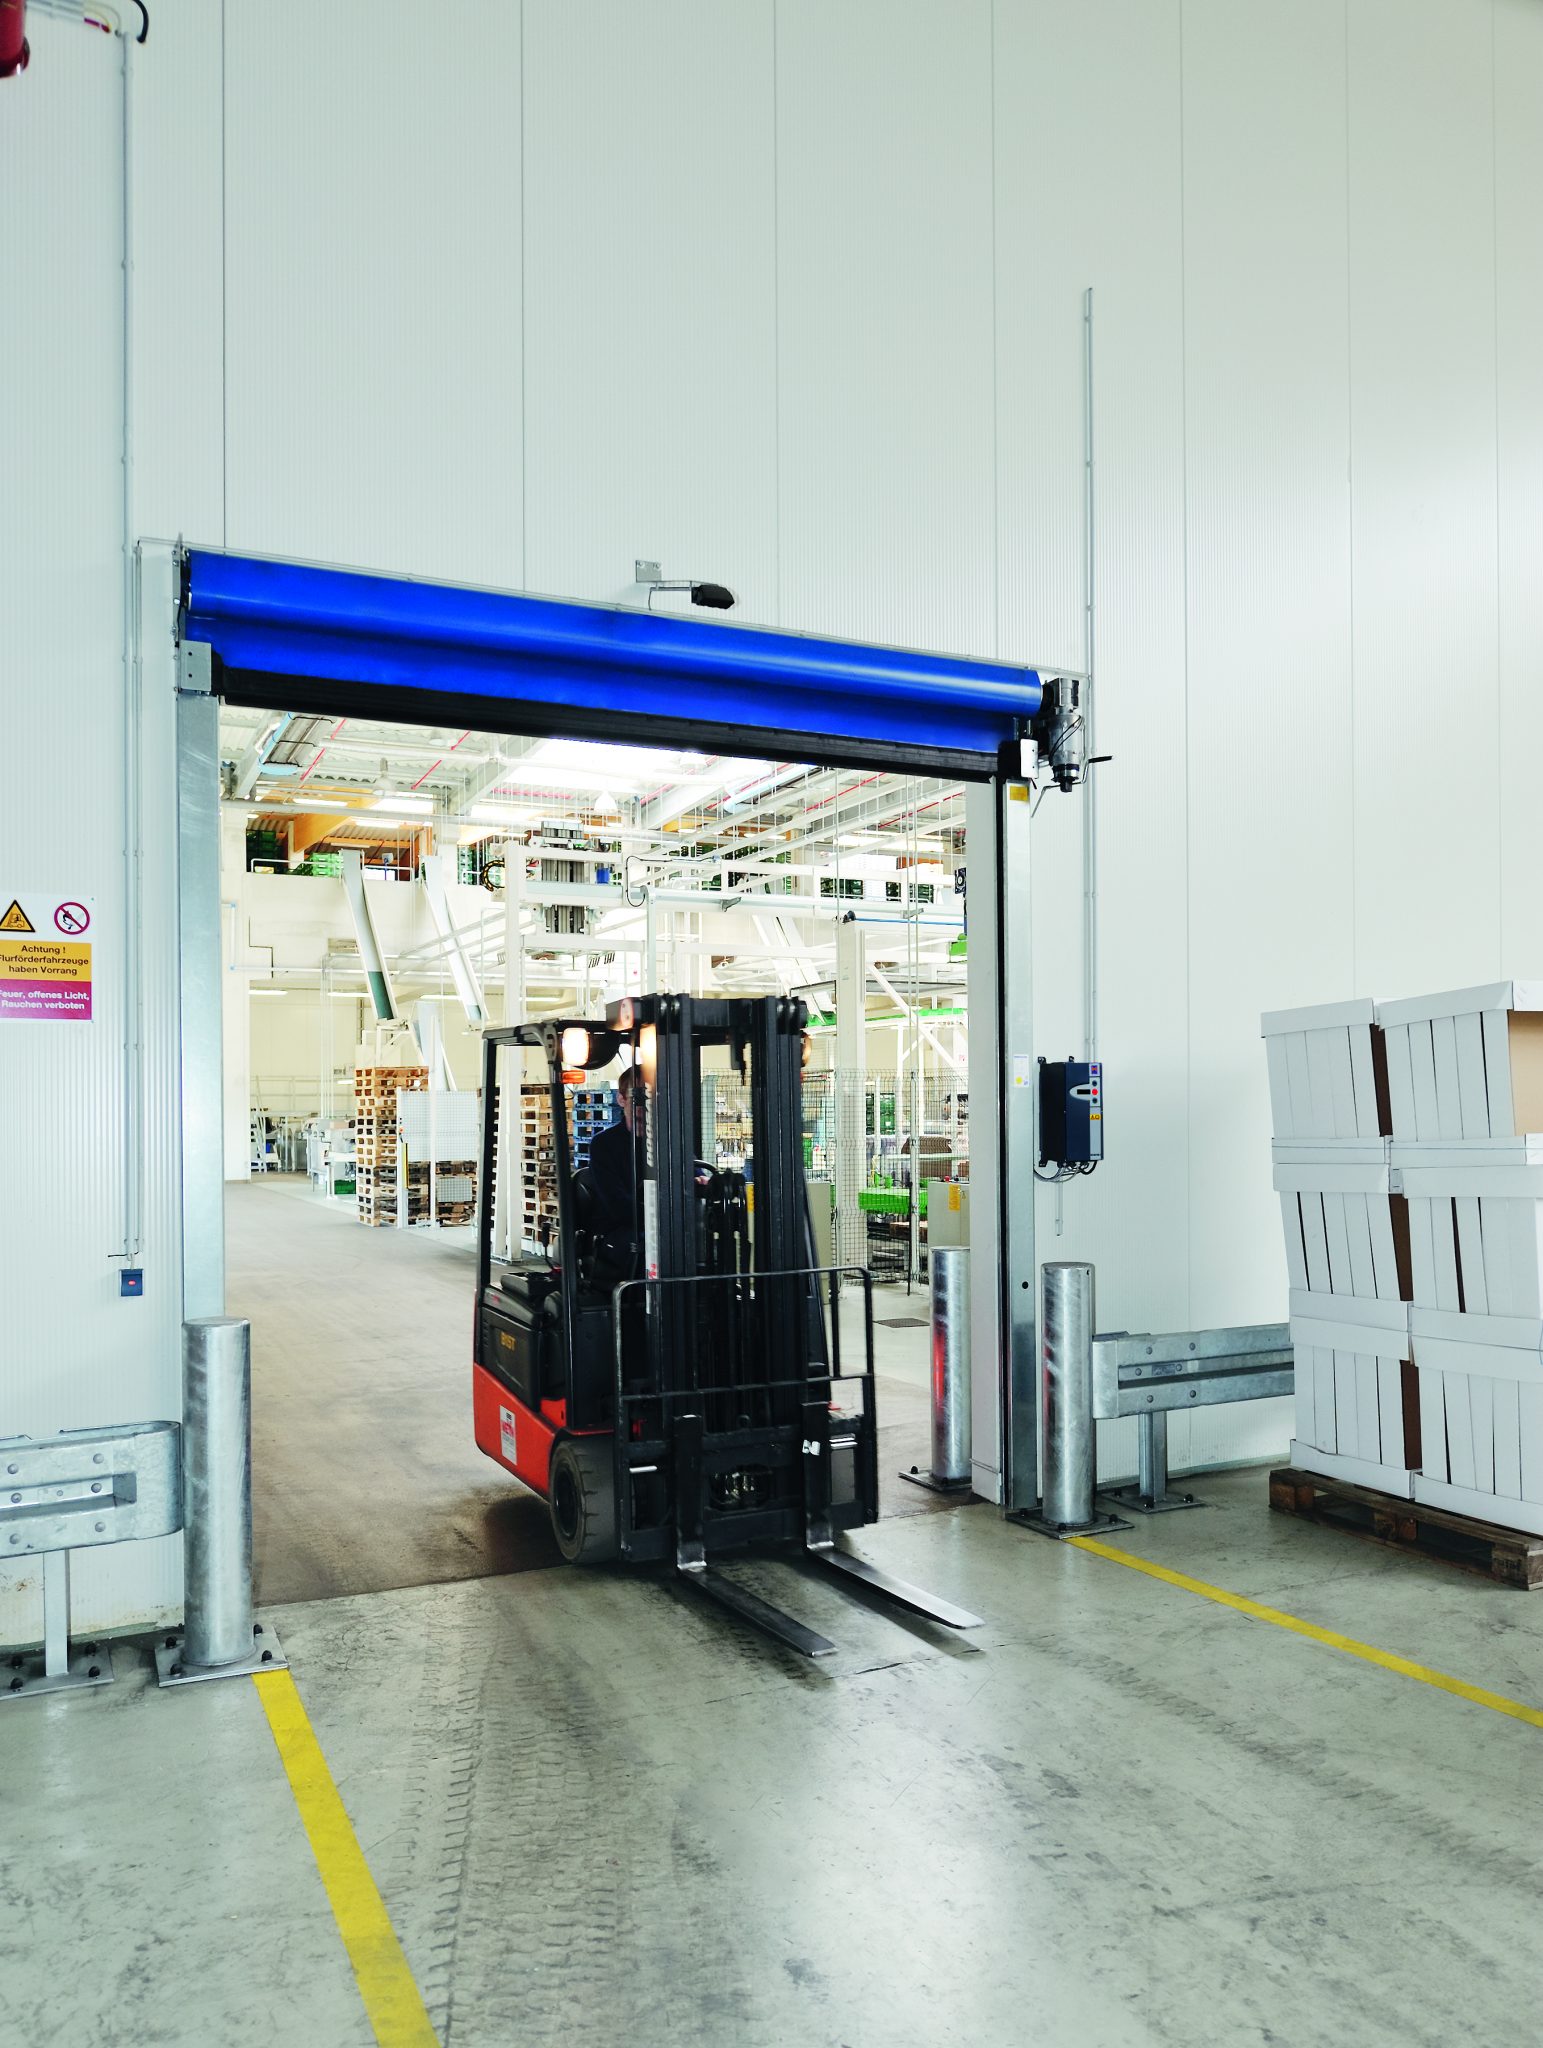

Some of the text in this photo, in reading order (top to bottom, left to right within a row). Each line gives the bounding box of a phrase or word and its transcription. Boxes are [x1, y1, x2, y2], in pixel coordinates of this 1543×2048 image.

[21, 945, 60, 955] Achtung
[40, 966, 77, 976] Vorrang
[28, 990, 63, 998] offenes
[64, 991, 90, 1001] Licht,
[1, 1000, 85, 1010] Rauchen verboten
[644, 1081, 654, 1168] DOOSAN
